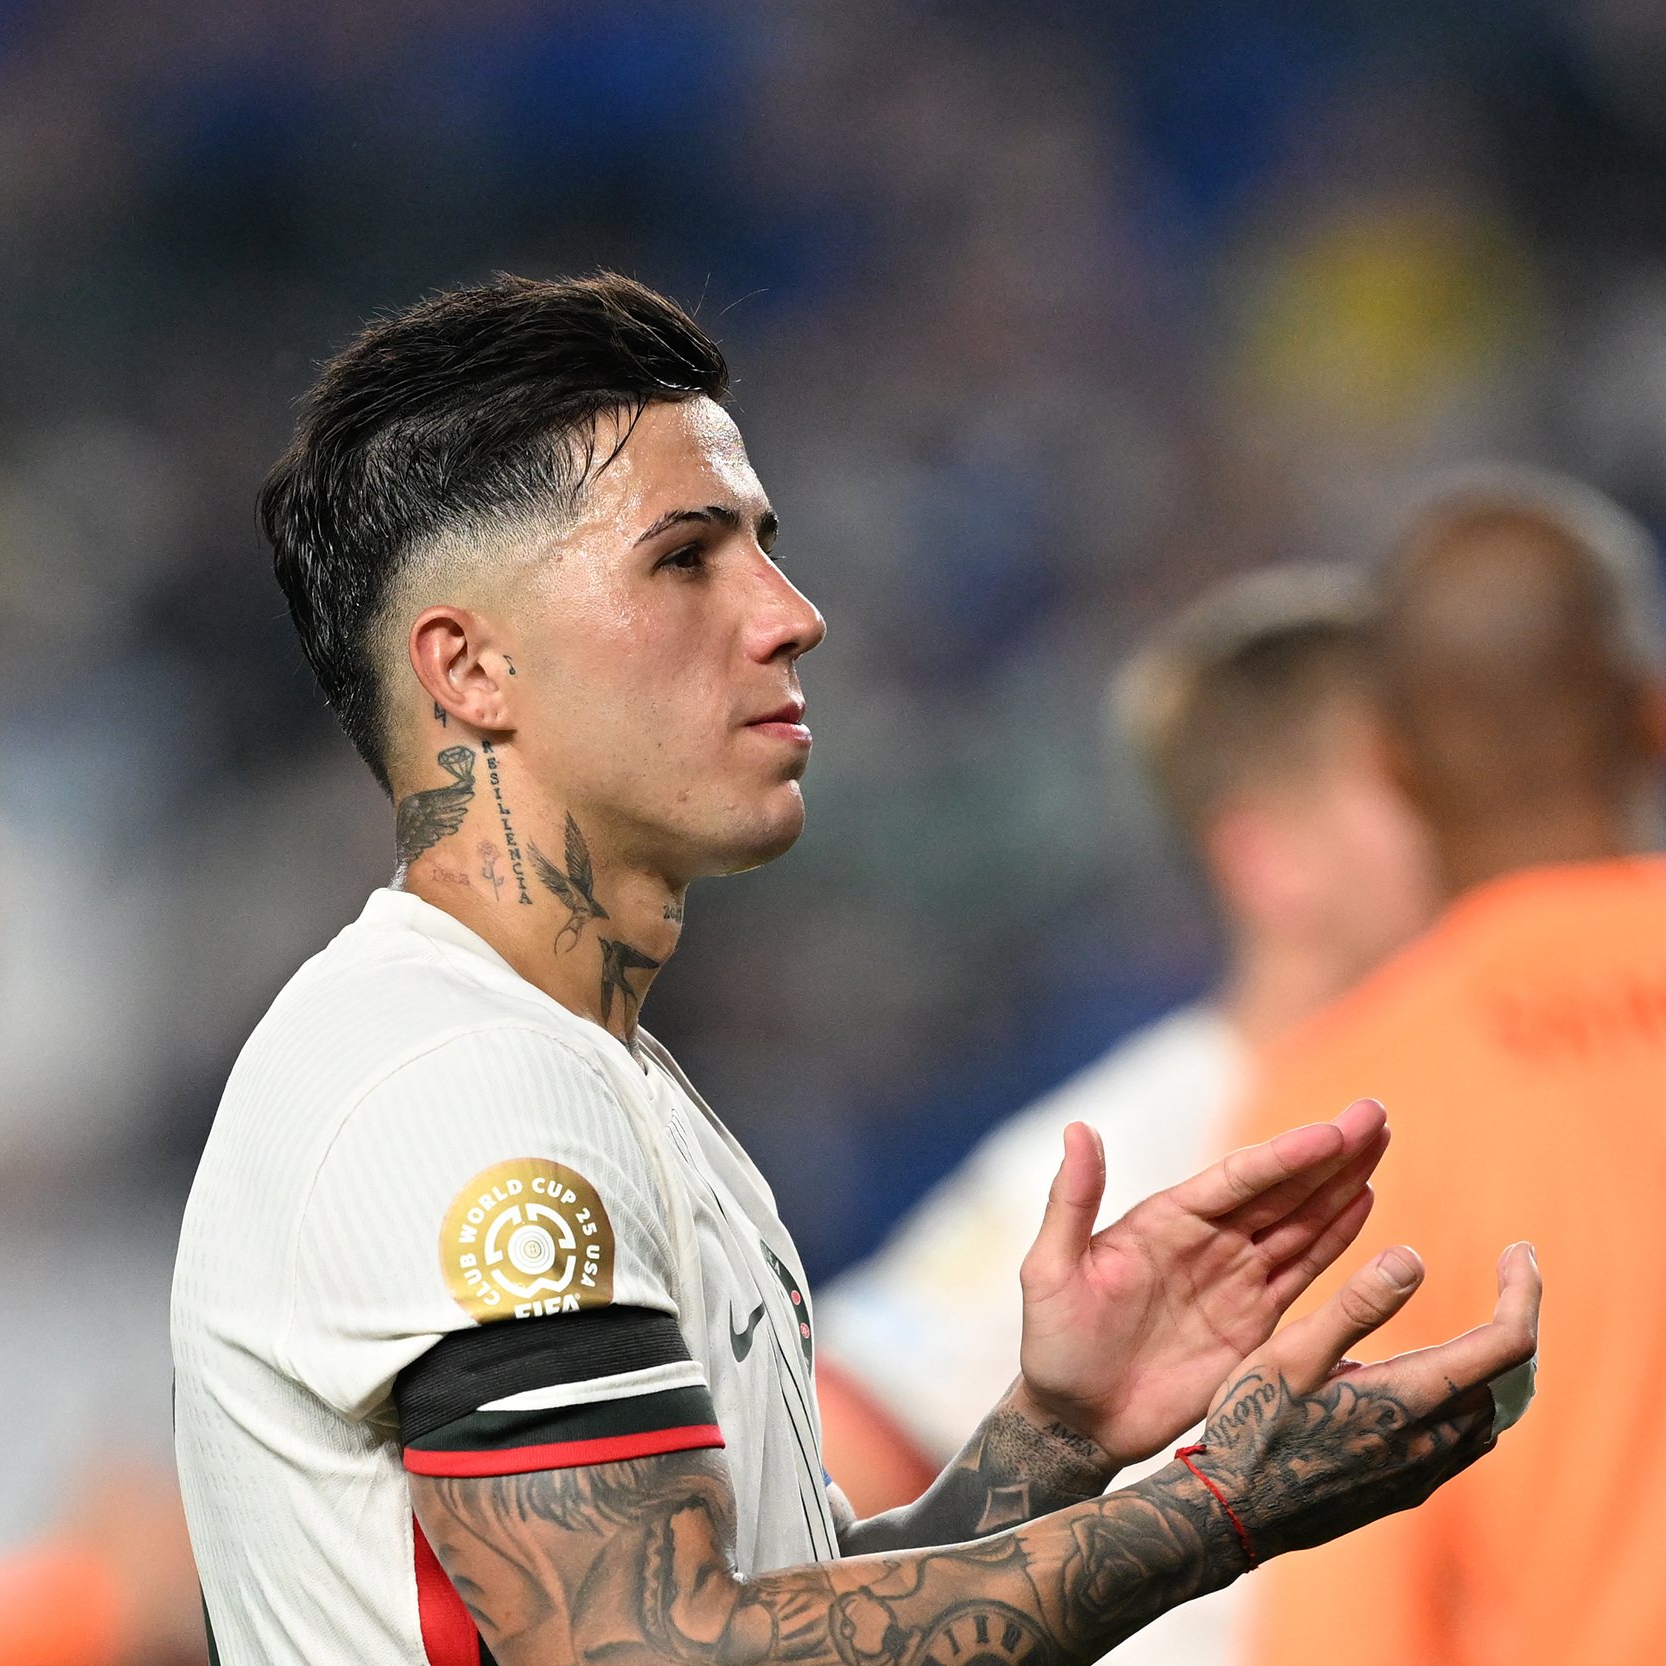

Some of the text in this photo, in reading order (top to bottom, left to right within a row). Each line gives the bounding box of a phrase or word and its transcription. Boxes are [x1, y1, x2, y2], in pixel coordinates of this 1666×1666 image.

[458, 1177, 601, 1306] CLUB WORLD CUP 25 USA
